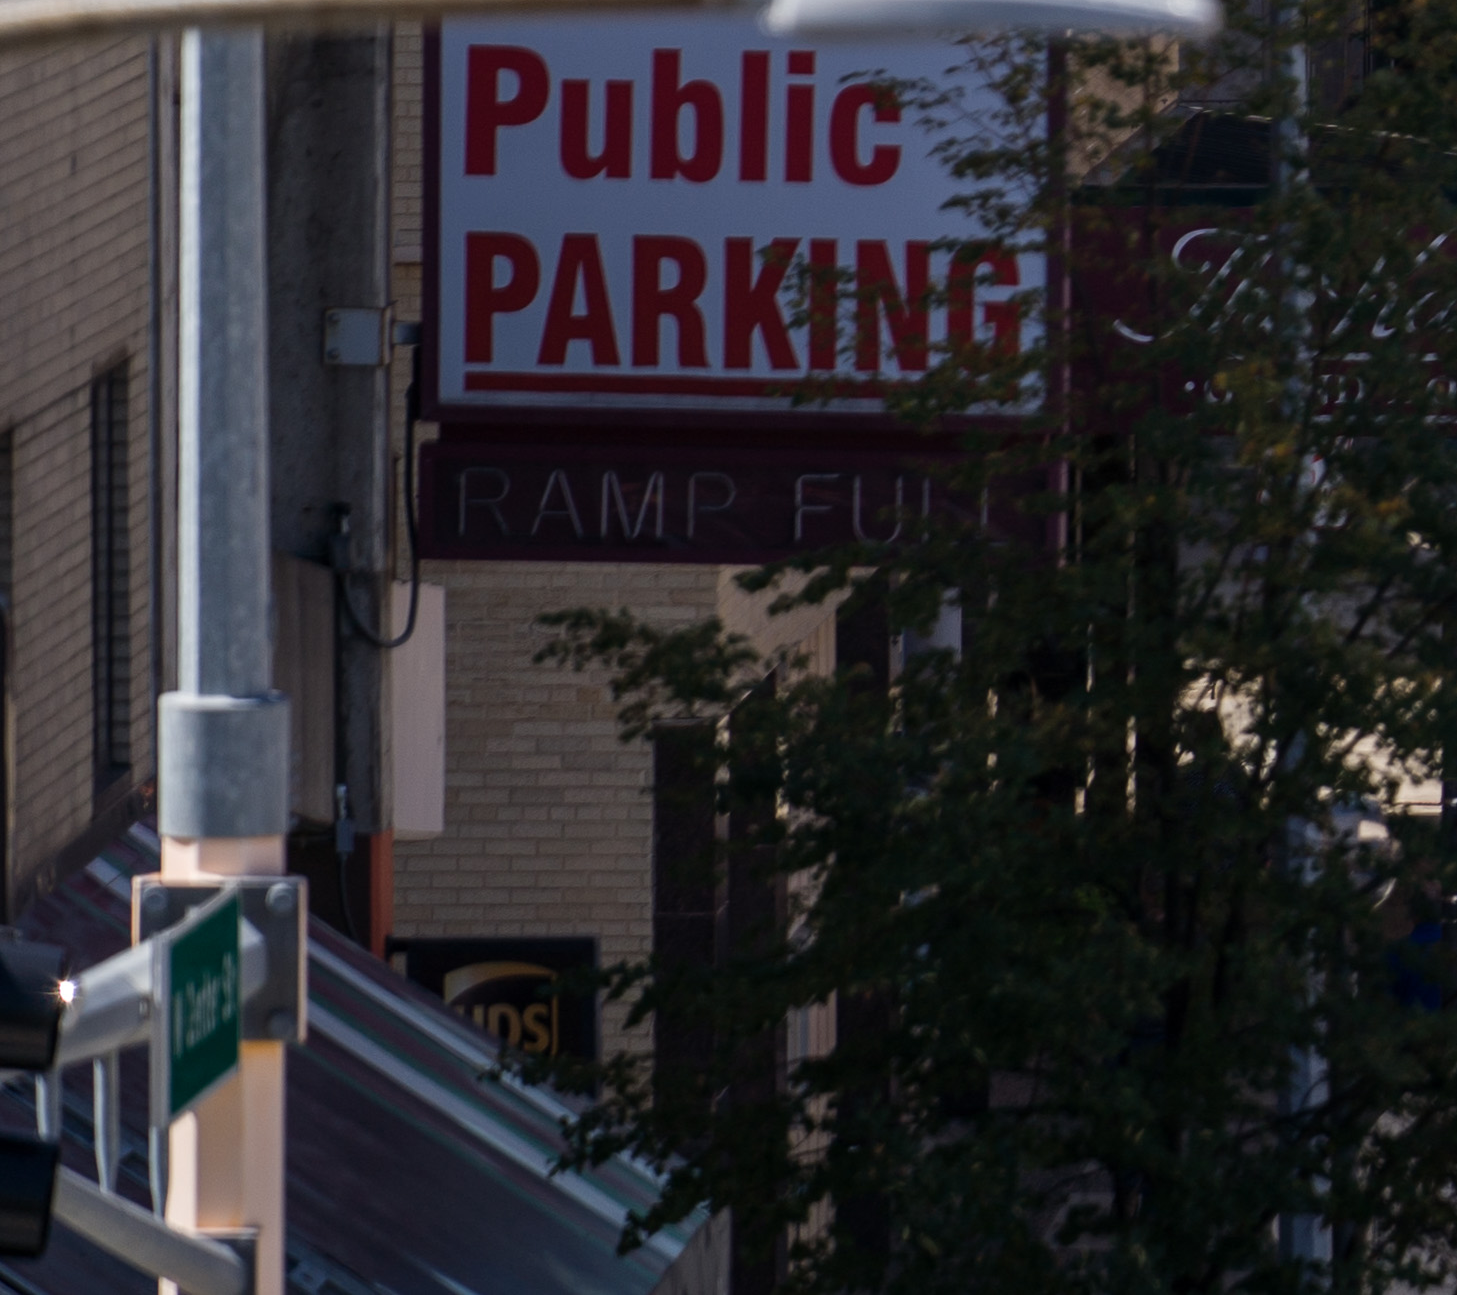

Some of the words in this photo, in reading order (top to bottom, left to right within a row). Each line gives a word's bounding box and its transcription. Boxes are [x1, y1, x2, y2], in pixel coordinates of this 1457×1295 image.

[463, 43, 903, 186] Public
[463, 230, 1022, 374] PARKING
[457, 467, 738, 540] RAMP
